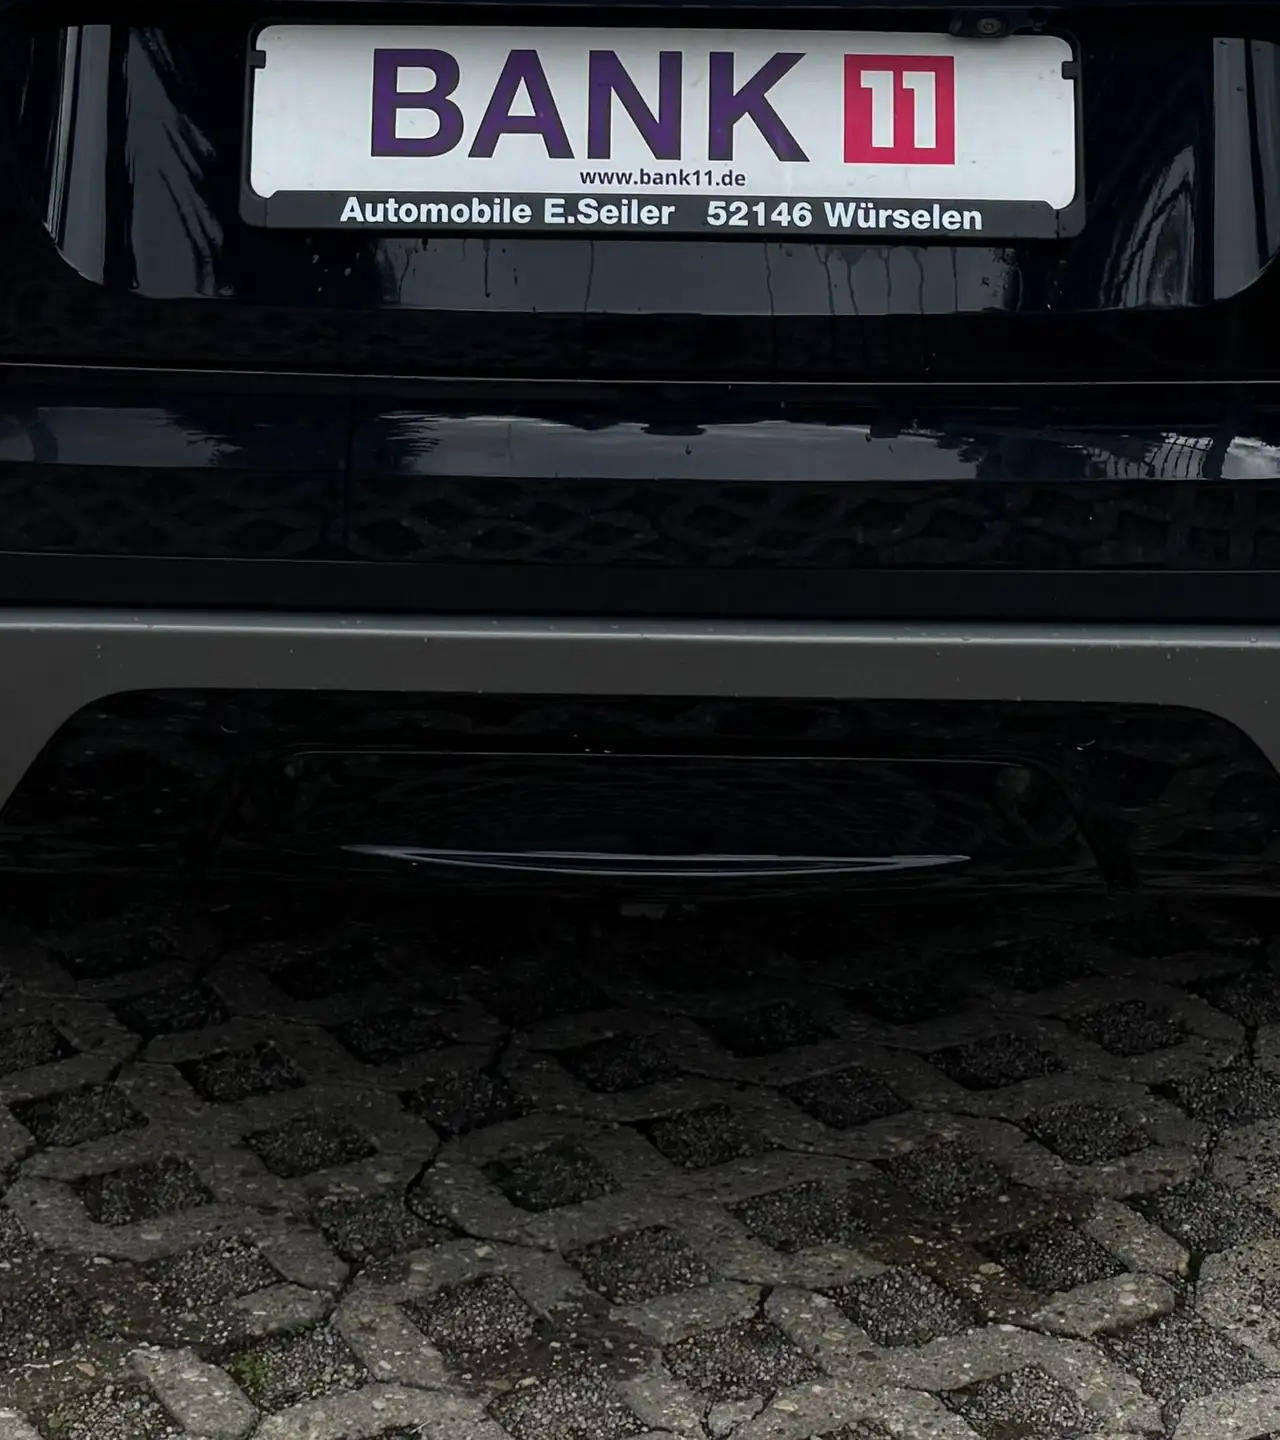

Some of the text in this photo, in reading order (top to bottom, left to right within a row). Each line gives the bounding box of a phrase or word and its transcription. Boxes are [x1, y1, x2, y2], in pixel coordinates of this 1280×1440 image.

[370, 47, 937, 162] BANK 11
[579, 167, 746, 190] www.bank11.de
[340, 198, 982, 231] Automobile E.Seiler 52146 Würselen
